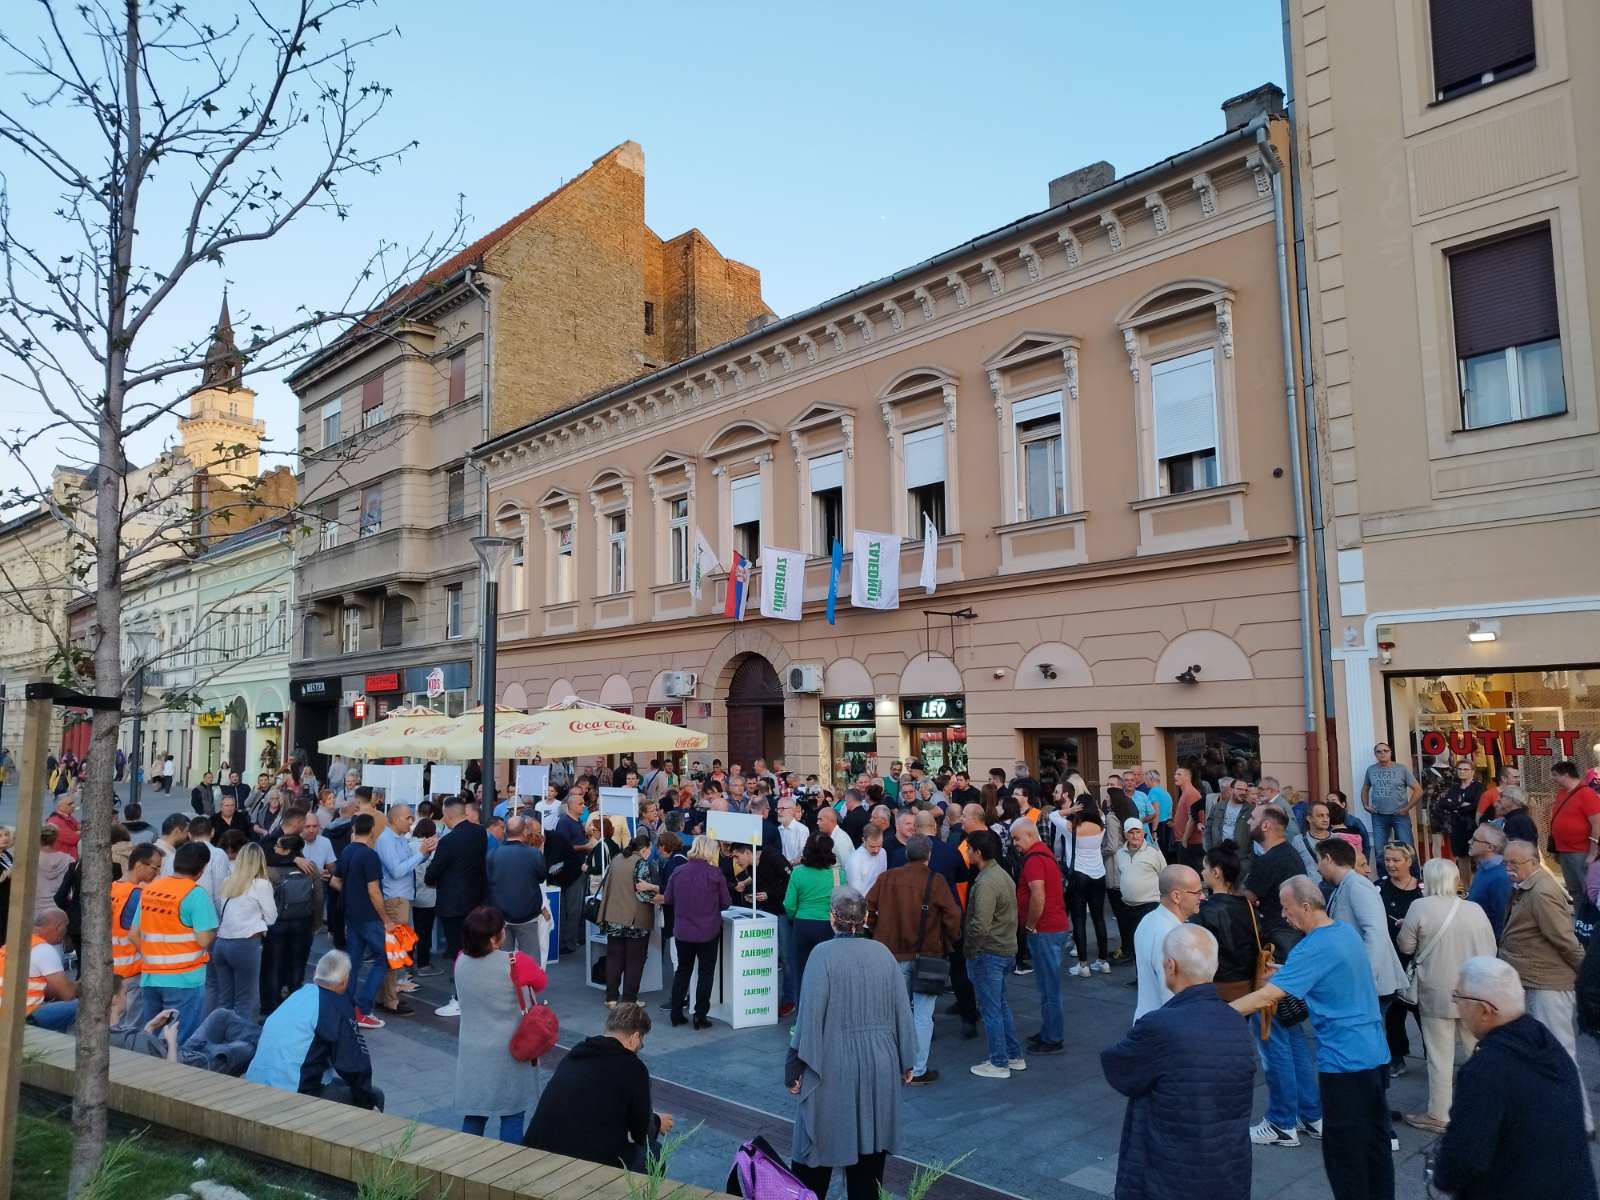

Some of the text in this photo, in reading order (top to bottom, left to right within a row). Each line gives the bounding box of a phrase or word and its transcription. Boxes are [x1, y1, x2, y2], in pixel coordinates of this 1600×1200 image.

[838, 703, 860, 719] LEO
[921, 700, 947, 718] LEO
[1423, 730, 1580, 756] OUTLET
[739, 928, 775, 939] ZAJEDNO!
[741, 947, 774, 958] ZAJEDNO!
[742, 967, 772, 977] ZAJEDNO!
